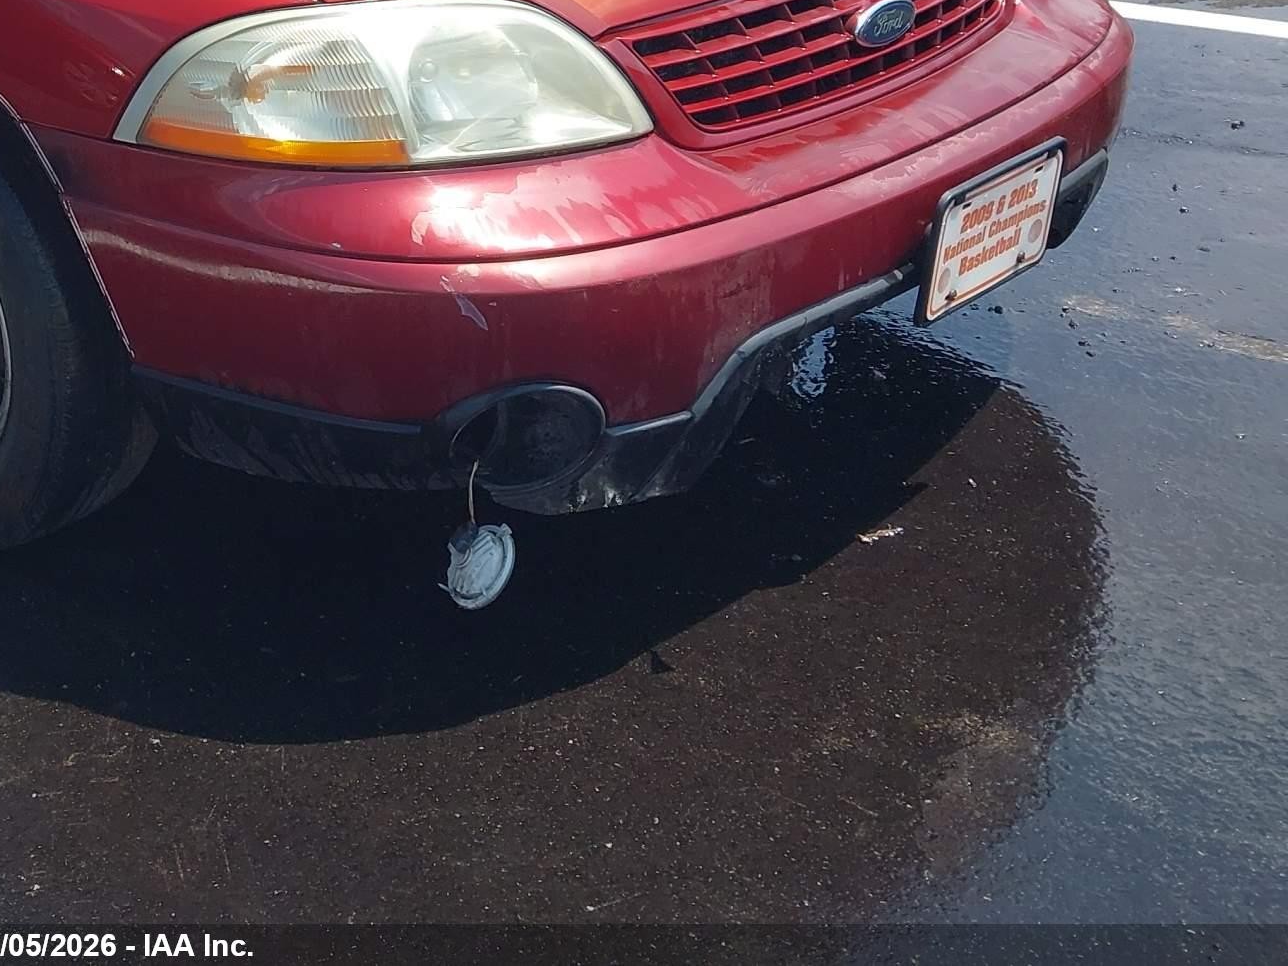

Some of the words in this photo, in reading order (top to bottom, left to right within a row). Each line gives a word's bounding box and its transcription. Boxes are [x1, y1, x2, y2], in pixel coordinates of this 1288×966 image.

[943, 226, 987, 265] National
[988, 199, 1047, 239] Champions
[960, 201, 995, 234] 2009
[1007, 179, 1039, 210] 2013
[958, 228, 1022, 277] Basketball
